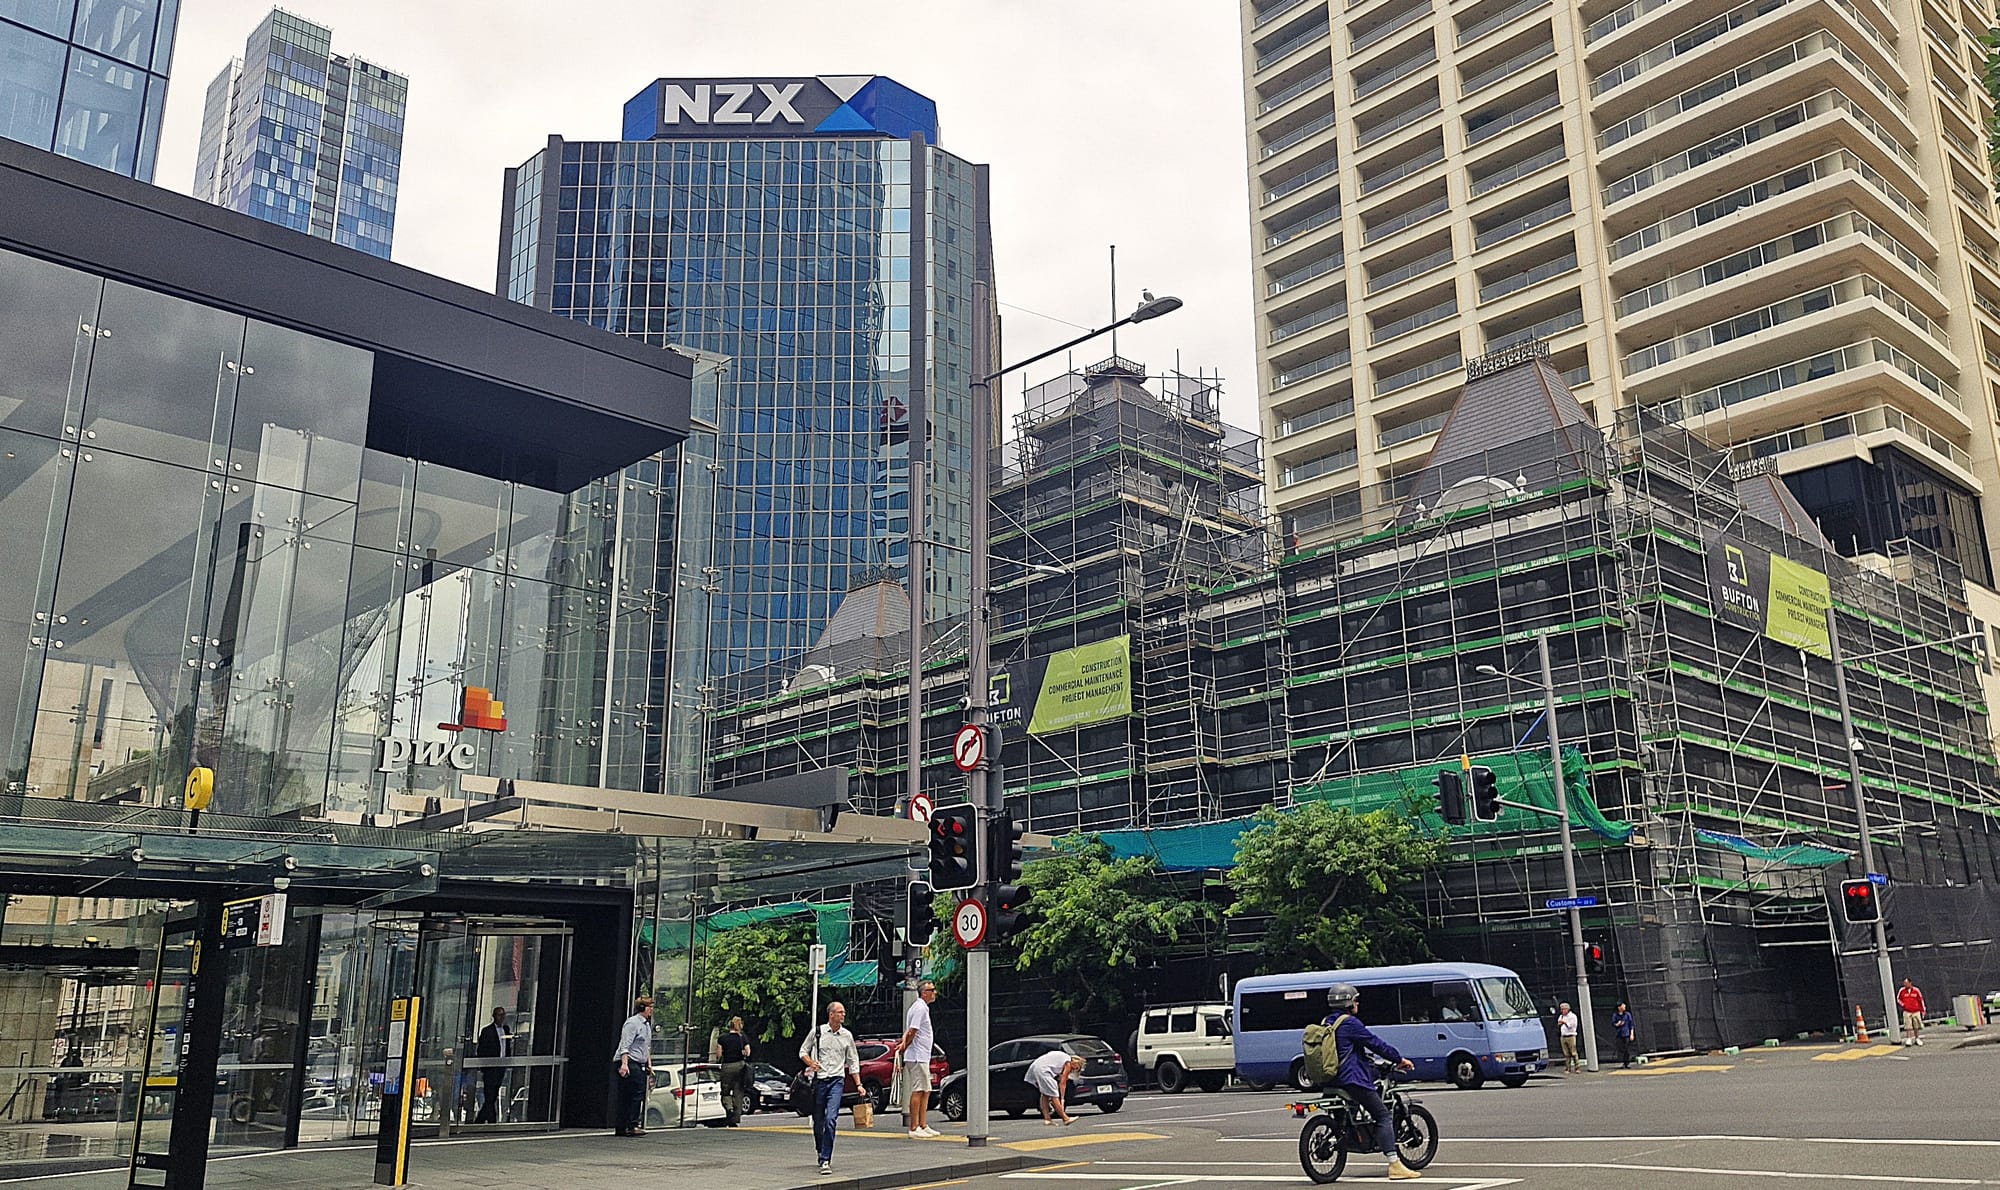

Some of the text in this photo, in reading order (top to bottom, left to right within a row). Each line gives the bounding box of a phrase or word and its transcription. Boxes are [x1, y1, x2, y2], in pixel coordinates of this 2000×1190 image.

[664, 84, 805, 123] NZX
[1721, 585, 1760, 613] BUFTON
[1724, 601, 1761, 622] CONSTRUCTION
[1081, 656, 1122, 674] CONSTRUCTION
[1048, 668, 1123, 695] COMMERCIAL MAINTENANCE
[1061, 681, 1123, 705] PROJECT MANAGEMENT
[986, 706, 1021, 723] UFTON
[378, 735, 475, 773] pwc
[189, 776, 198, 799] C
[1550, 899, 1576, 908] Customs
[961, 913, 979, 932] 30
